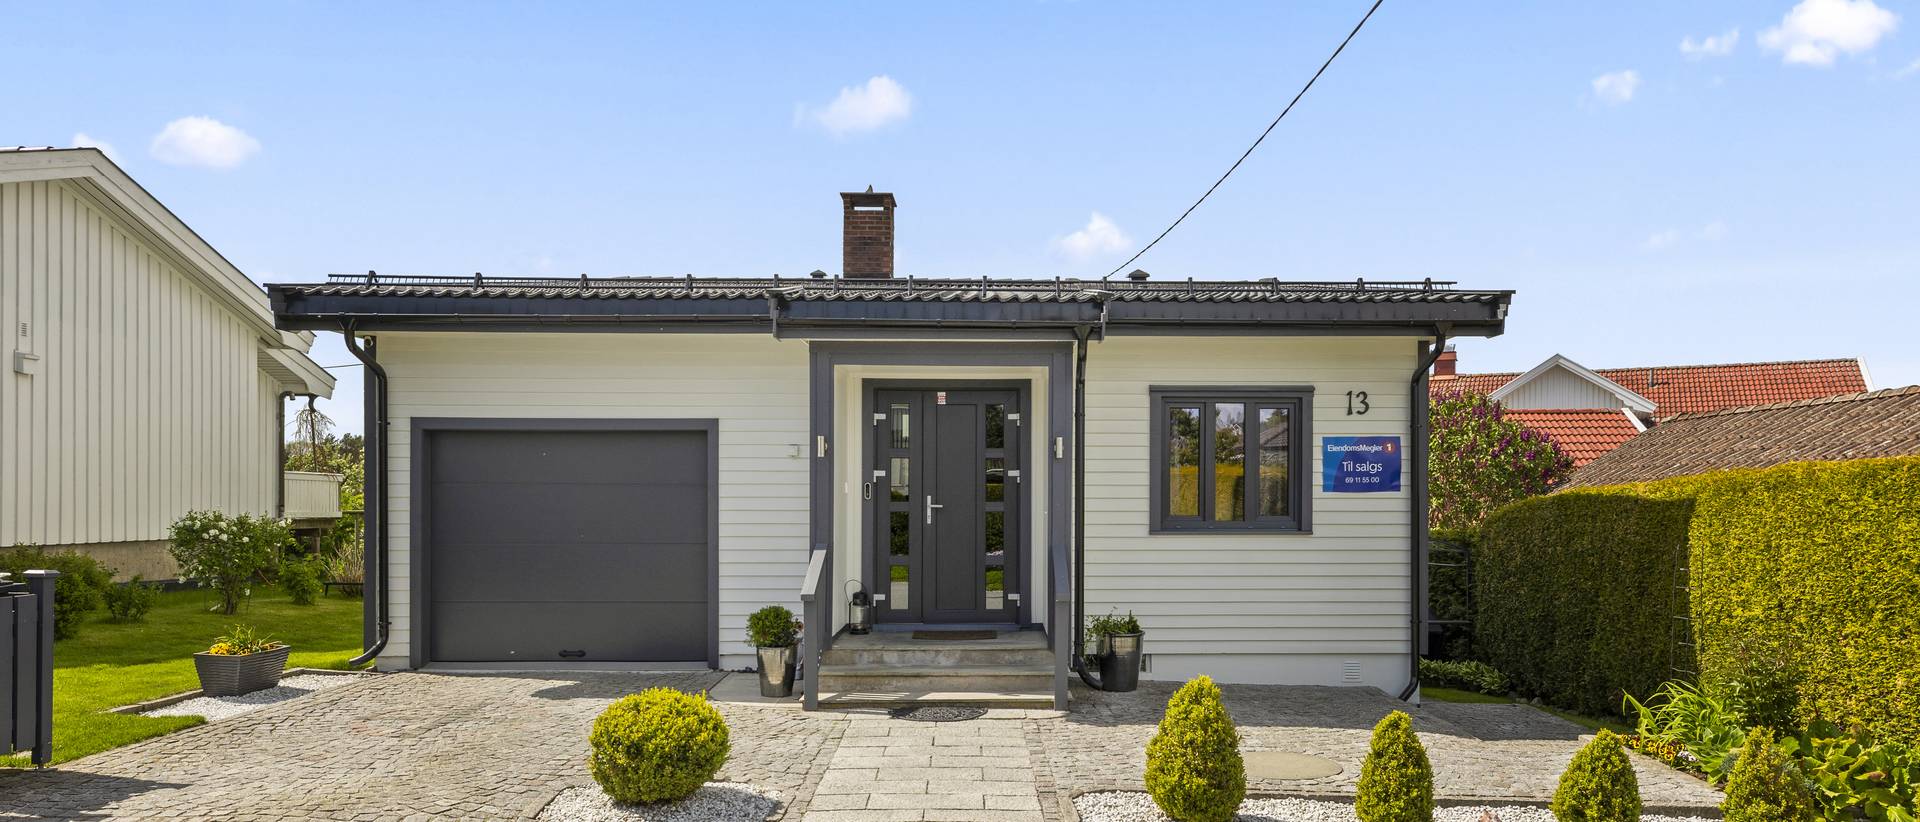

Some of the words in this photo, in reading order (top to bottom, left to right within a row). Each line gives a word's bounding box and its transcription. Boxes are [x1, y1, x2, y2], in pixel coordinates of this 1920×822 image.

[1346, 390, 1370, 416] 13
[1327, 444, 1383, 453] EiendomsMegler
[1342, 461, 1353, 472] Til
[1355, 461, 1383, 474] salgs
[1345, 476, 1354, 484] 69
